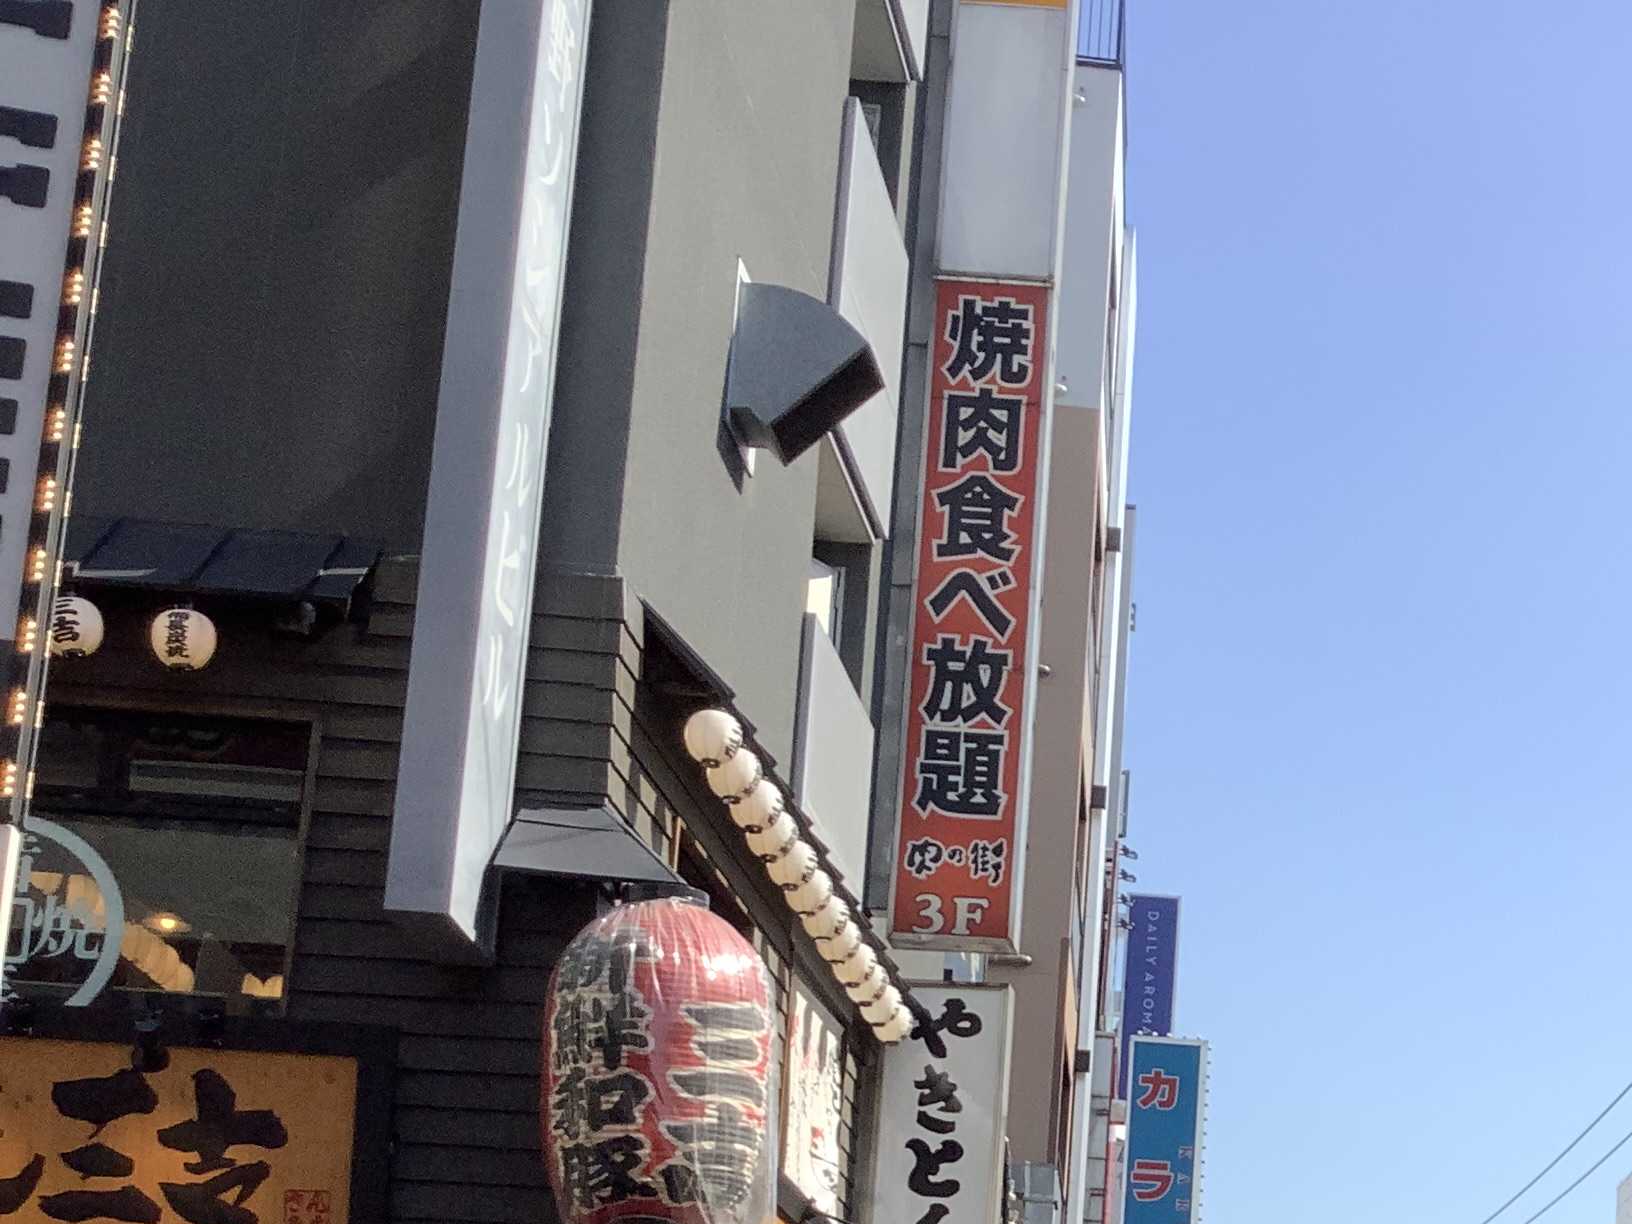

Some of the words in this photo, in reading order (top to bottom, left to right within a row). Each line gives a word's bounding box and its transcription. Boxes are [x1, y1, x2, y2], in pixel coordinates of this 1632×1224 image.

[911, 295, 1035, 820] 焼肉食べ放題
[903, 837, 1007, 887] 肉の街
[911, 892, 989, 937] 3F
[1145, 911, 1160, 966] DAILY
[1141, 972, 1156, 1035] AROMA
[656, 1001, 769, 1211] 三吉
